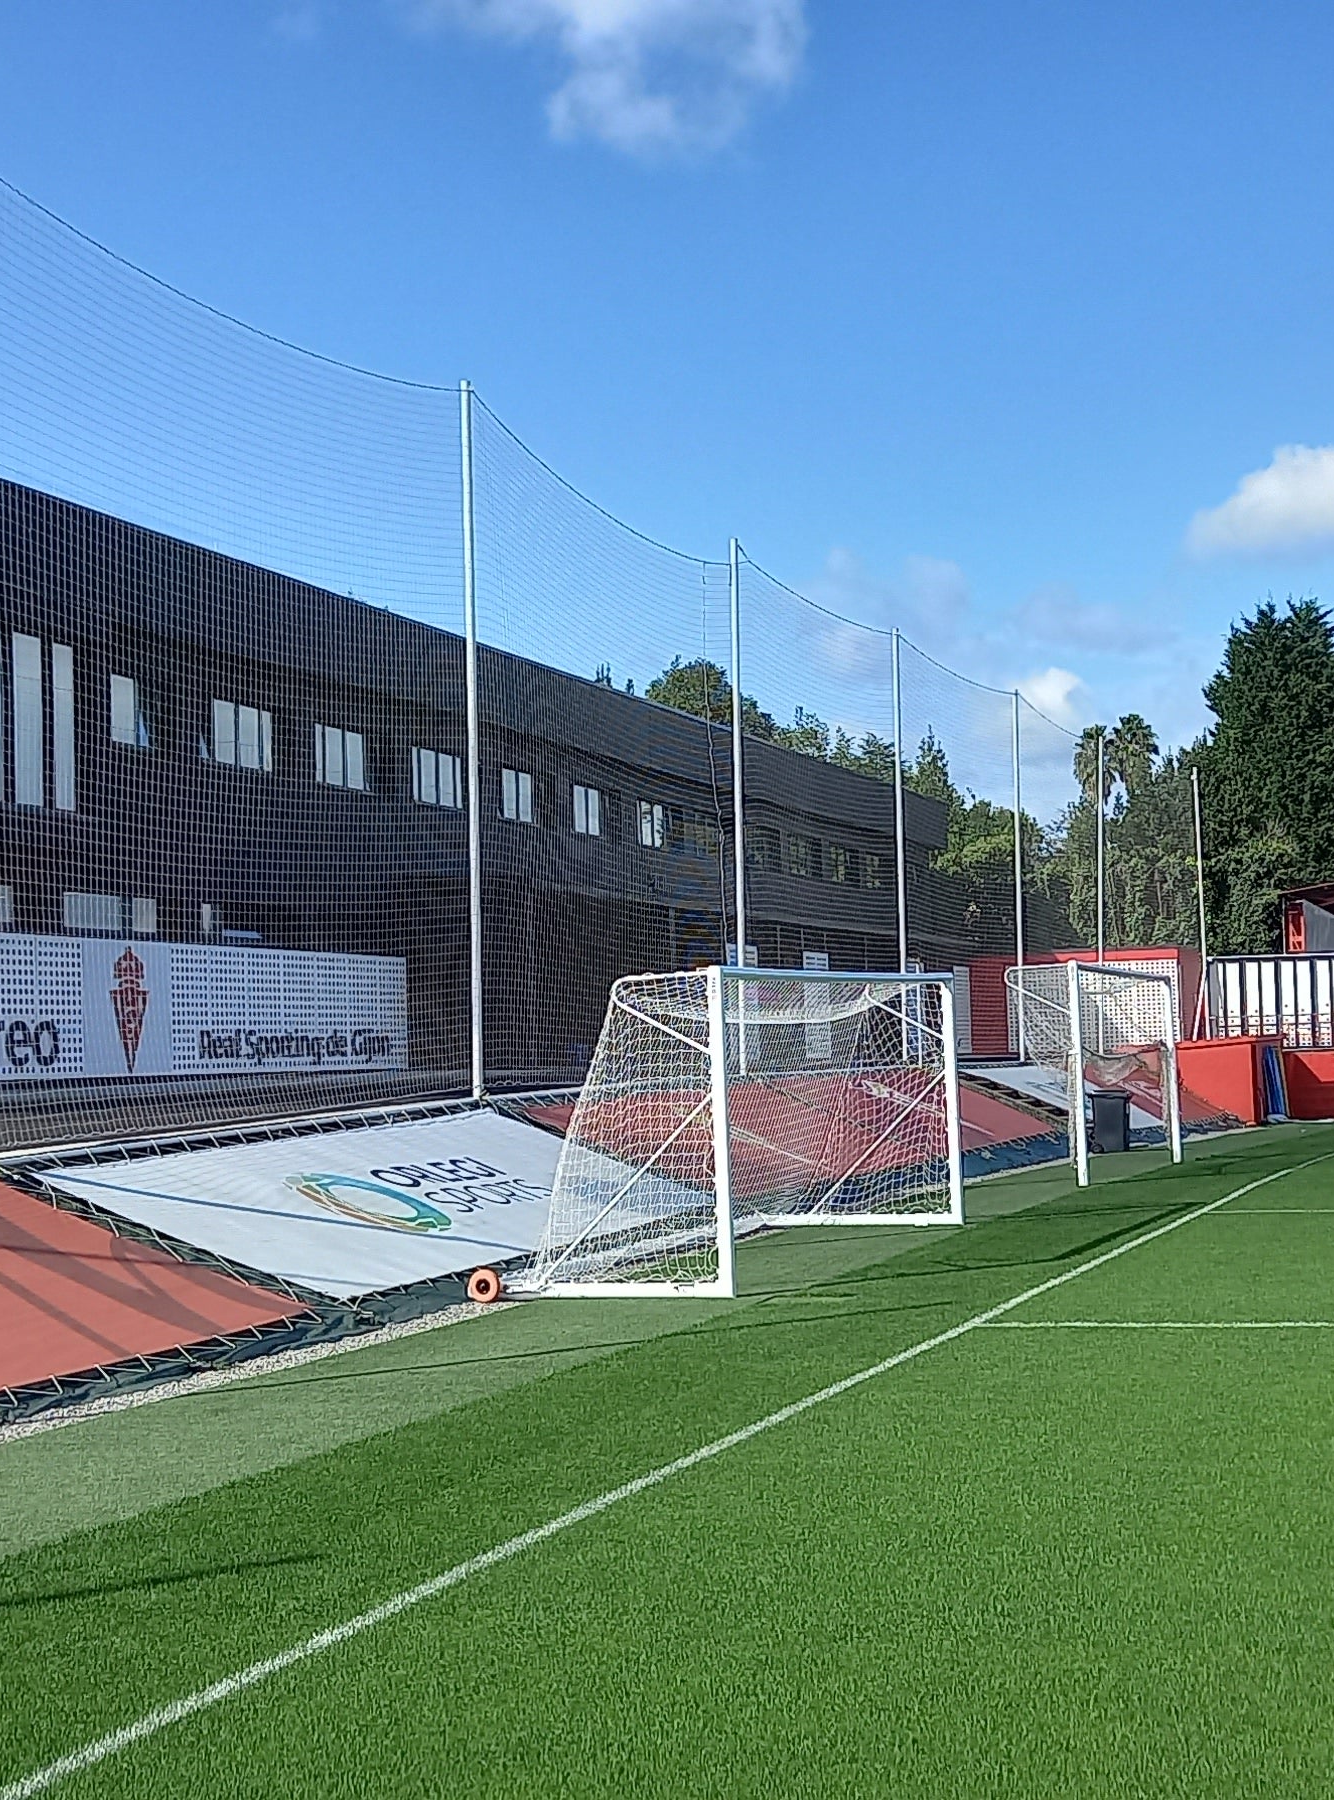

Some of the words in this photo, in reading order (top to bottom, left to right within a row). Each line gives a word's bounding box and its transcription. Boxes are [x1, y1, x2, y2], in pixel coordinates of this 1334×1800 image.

[199, 1029, 243, 1059] Real
[245, 1029, 322, 1066] Sporting
[326, 1029, 348, 1057] de
[370, 1157, 507, 1188] ORLEGI
[424, 1178, 554, 1213] SPORTS
